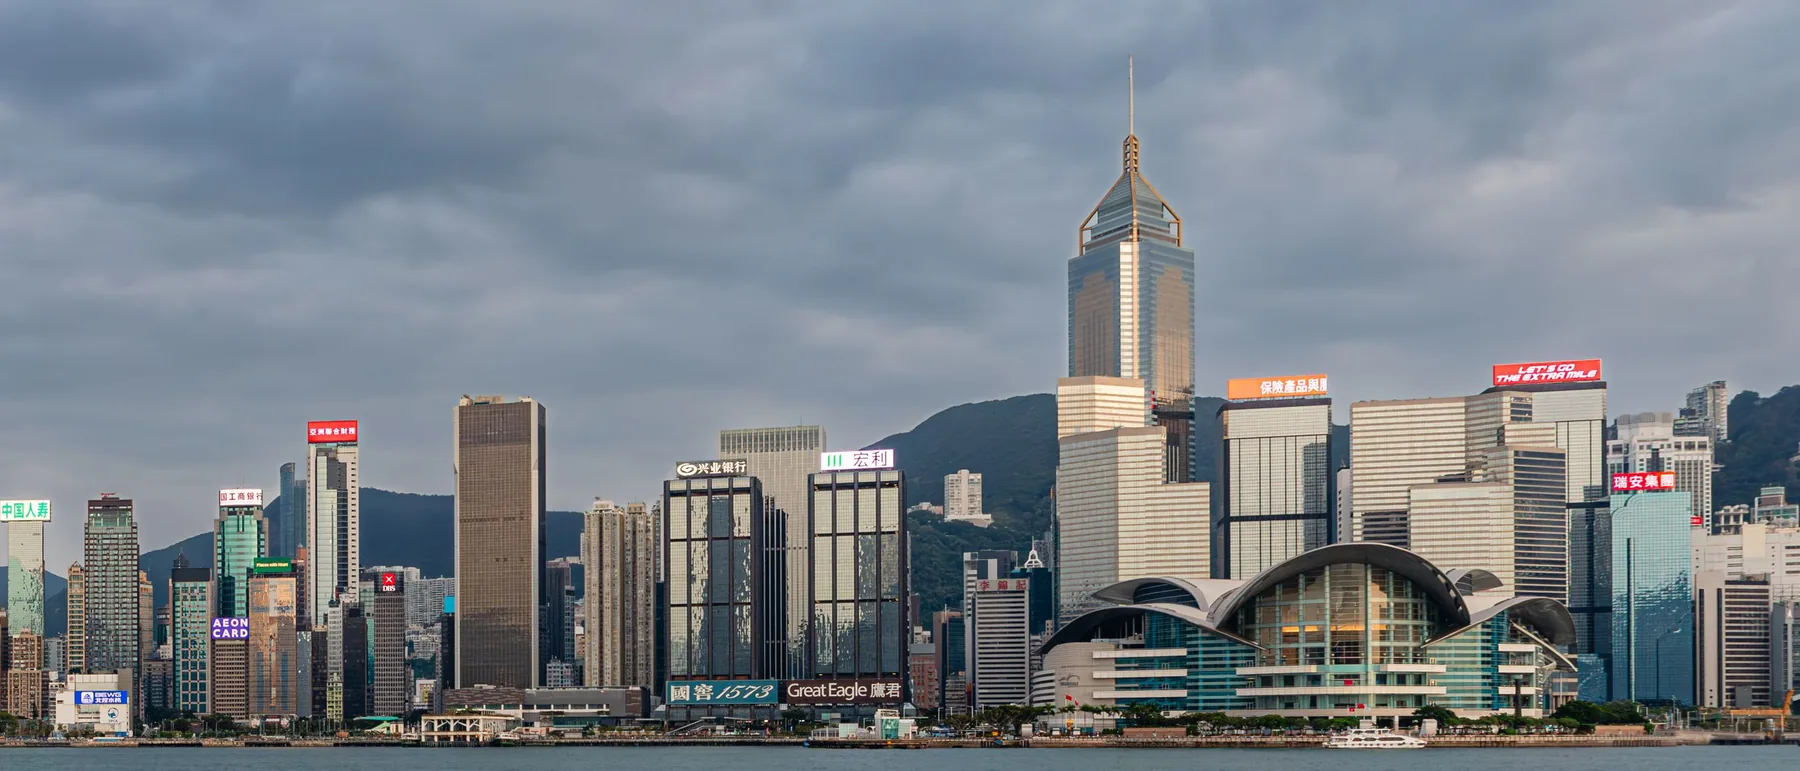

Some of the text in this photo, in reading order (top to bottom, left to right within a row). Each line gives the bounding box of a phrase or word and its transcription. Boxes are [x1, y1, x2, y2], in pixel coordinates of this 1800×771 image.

[1518, 363, 1575, 374] LET'S GO
[1497, 369, 1597, 382] THE EXTRA MILE
[854, 451, 887, 467] 宏利
[697, 461, 747, 474] 兴业银行
[1613, 474, 1674, 488] 瑞安集團
[2, 502, 48, 518] 中国人寿
[979, 580, 1027, 591] 李錦記
[213, 618, 248, 628] AEON
[212, 628, 248, 638] CARD
[787, 681, 902, 701] Great Eagle 鷹君
